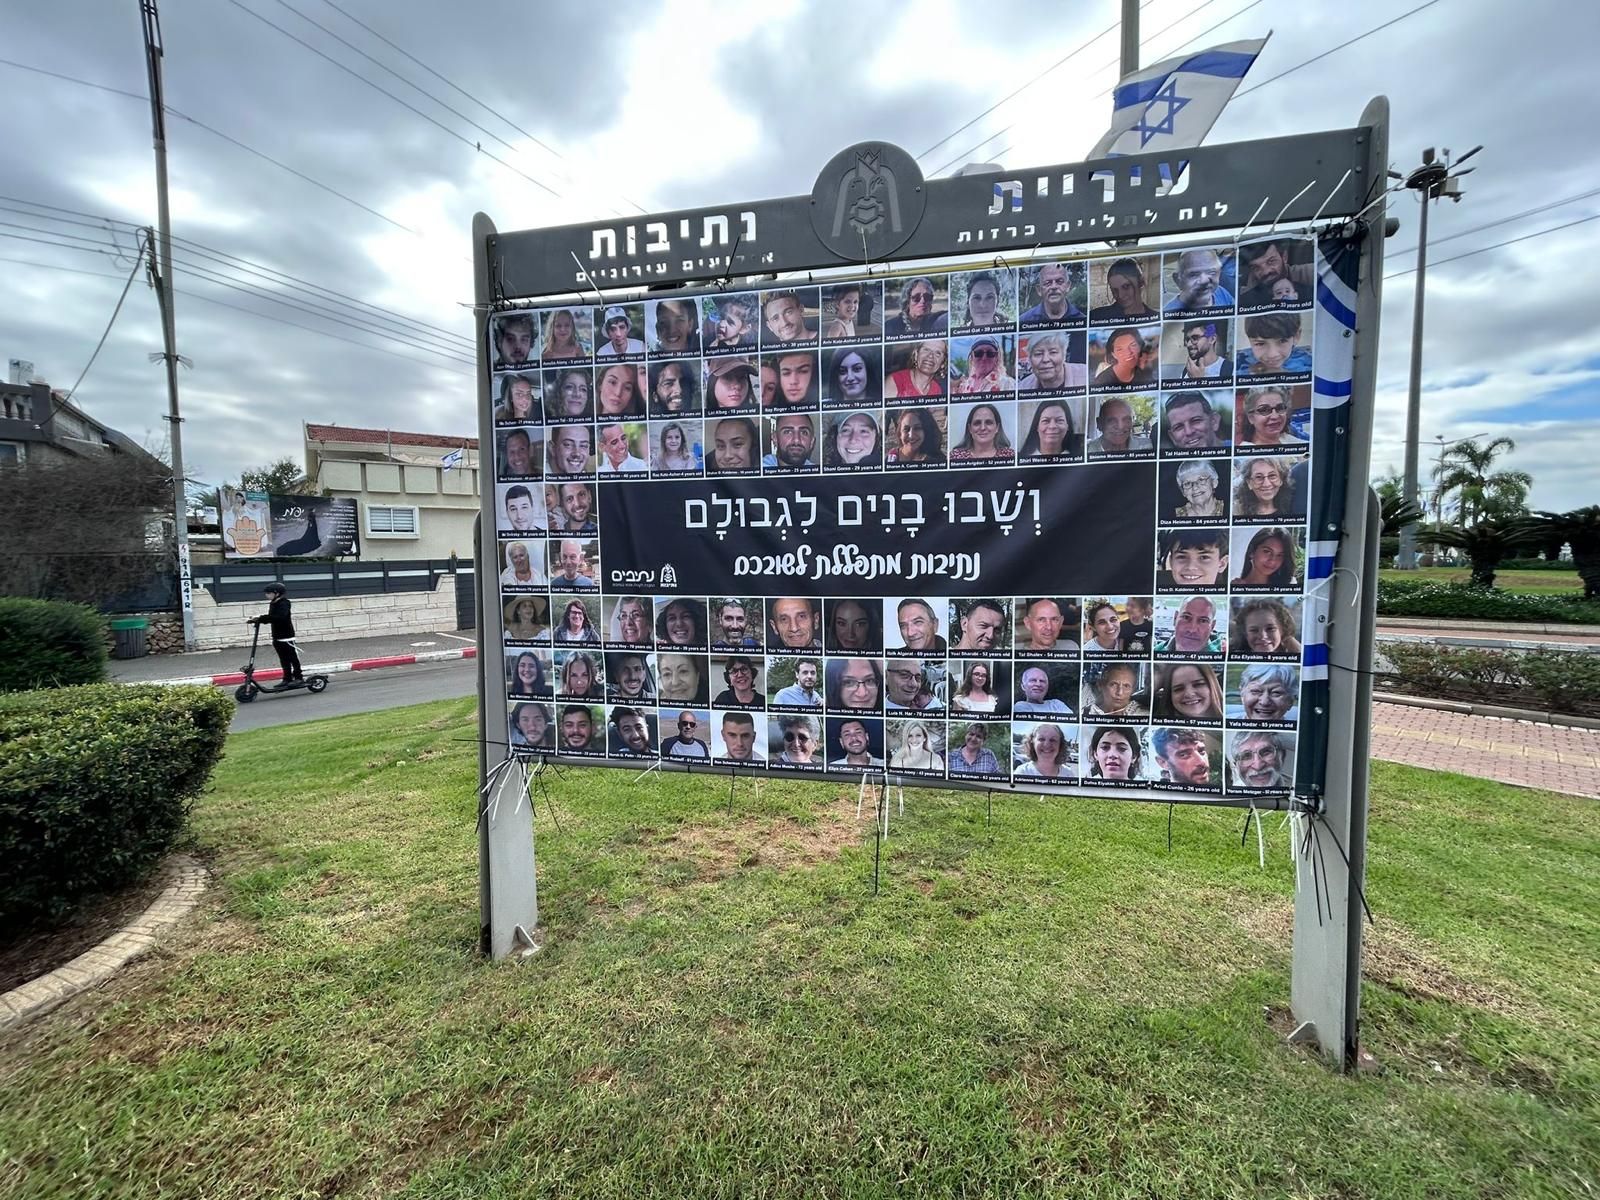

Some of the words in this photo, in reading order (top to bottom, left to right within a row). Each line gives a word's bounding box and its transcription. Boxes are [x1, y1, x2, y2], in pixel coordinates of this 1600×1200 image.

[988, 160, 1190, 215] עיריית
[1178, 202, 1228, 221] לוח
[589, 211, 757, 259] נתיבות
[957, 224, 1036, 244] כרזות
[734, 544, 812, 576] לשובכם
[810, 544, 902, 580] מתפללת
[904, 552, 980, 582] נתיבות
[611, 570, 654, 582] נתיבים
